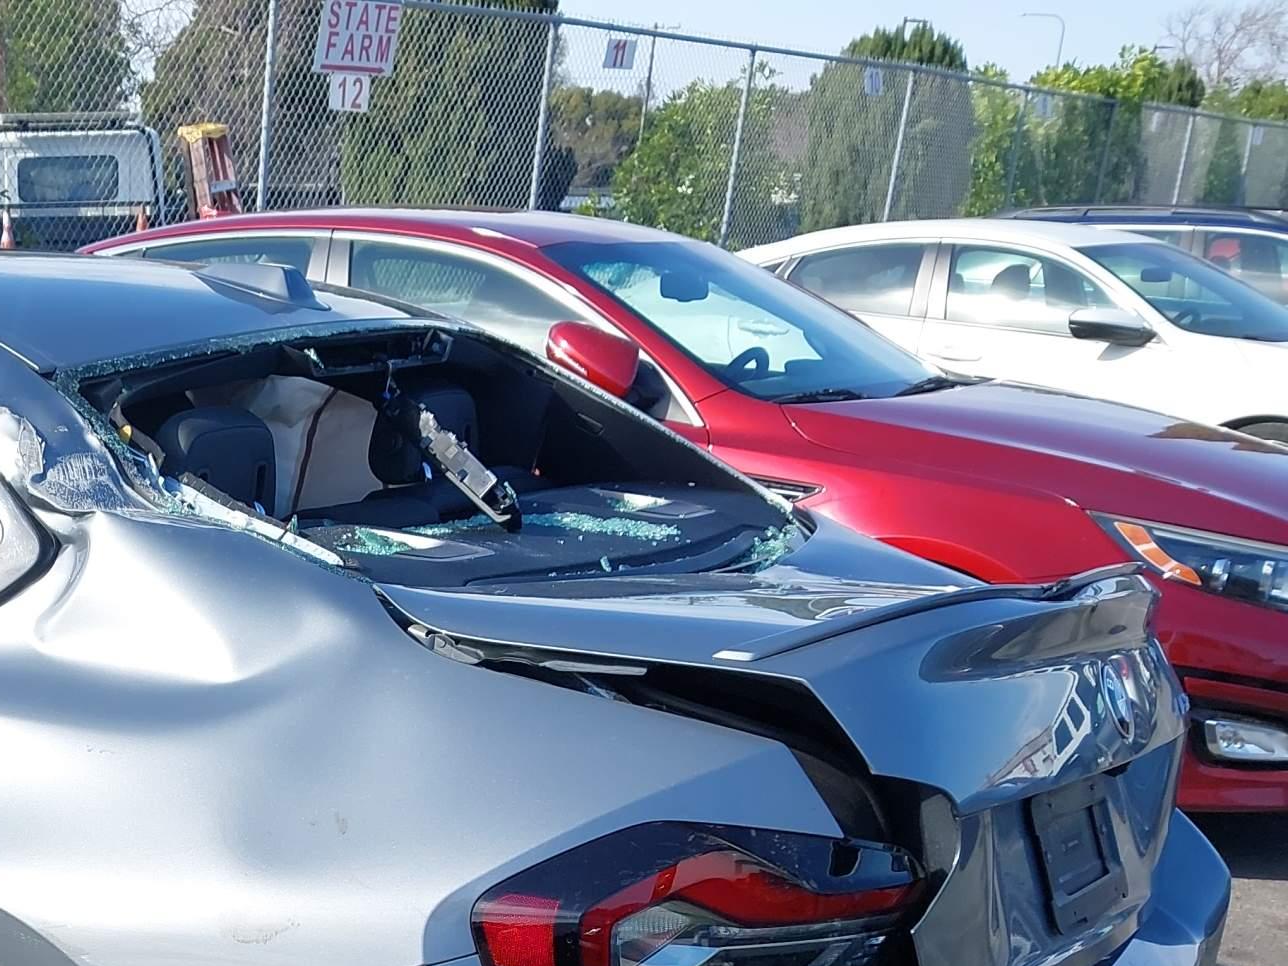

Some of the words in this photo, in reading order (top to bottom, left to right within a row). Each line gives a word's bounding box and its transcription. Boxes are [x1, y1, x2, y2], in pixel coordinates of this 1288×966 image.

[327, 0, 400, 34] STATE
[325, 31, 392, 63] FARM
[613, 40, 627, 67] 11
[338, 76, 364, 109] 12
